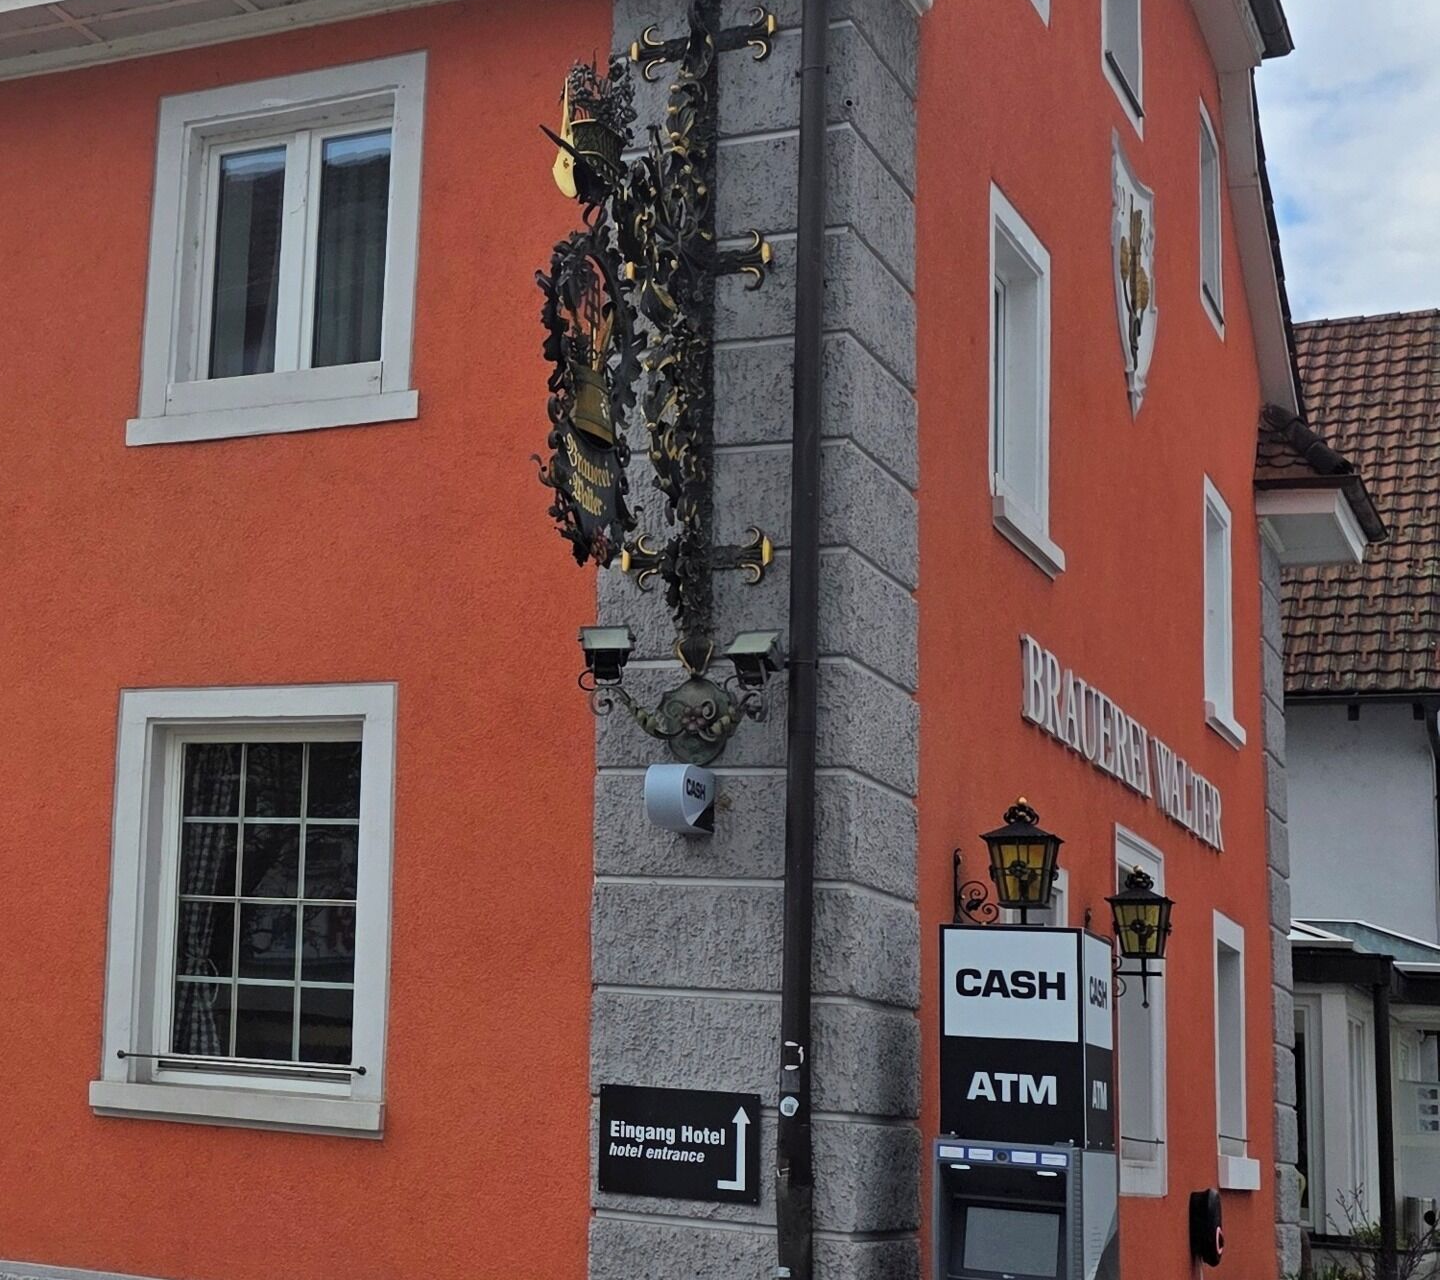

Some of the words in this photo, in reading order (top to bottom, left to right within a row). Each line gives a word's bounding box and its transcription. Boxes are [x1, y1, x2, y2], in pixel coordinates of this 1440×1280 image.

[1019, 633, 1152, 800] BRAUEREI
[1149, 736, 1225, 853] WALTER
[686, 778, 706, 801] CASH
[955, 968, 1066, 1001] CASH
[1089, 975, 1108, 1010] CASH
[966, 1071, 1058, 1106] ATM
[1091, 1080, 1108, 1111] ATM
[609, 1120, 676, 1145] Eingang
[681, 1125, 726, 1146] Hotel
[609, 1142, 643, 1159] hotel
[645, 1146, 705, 1163] entrance
